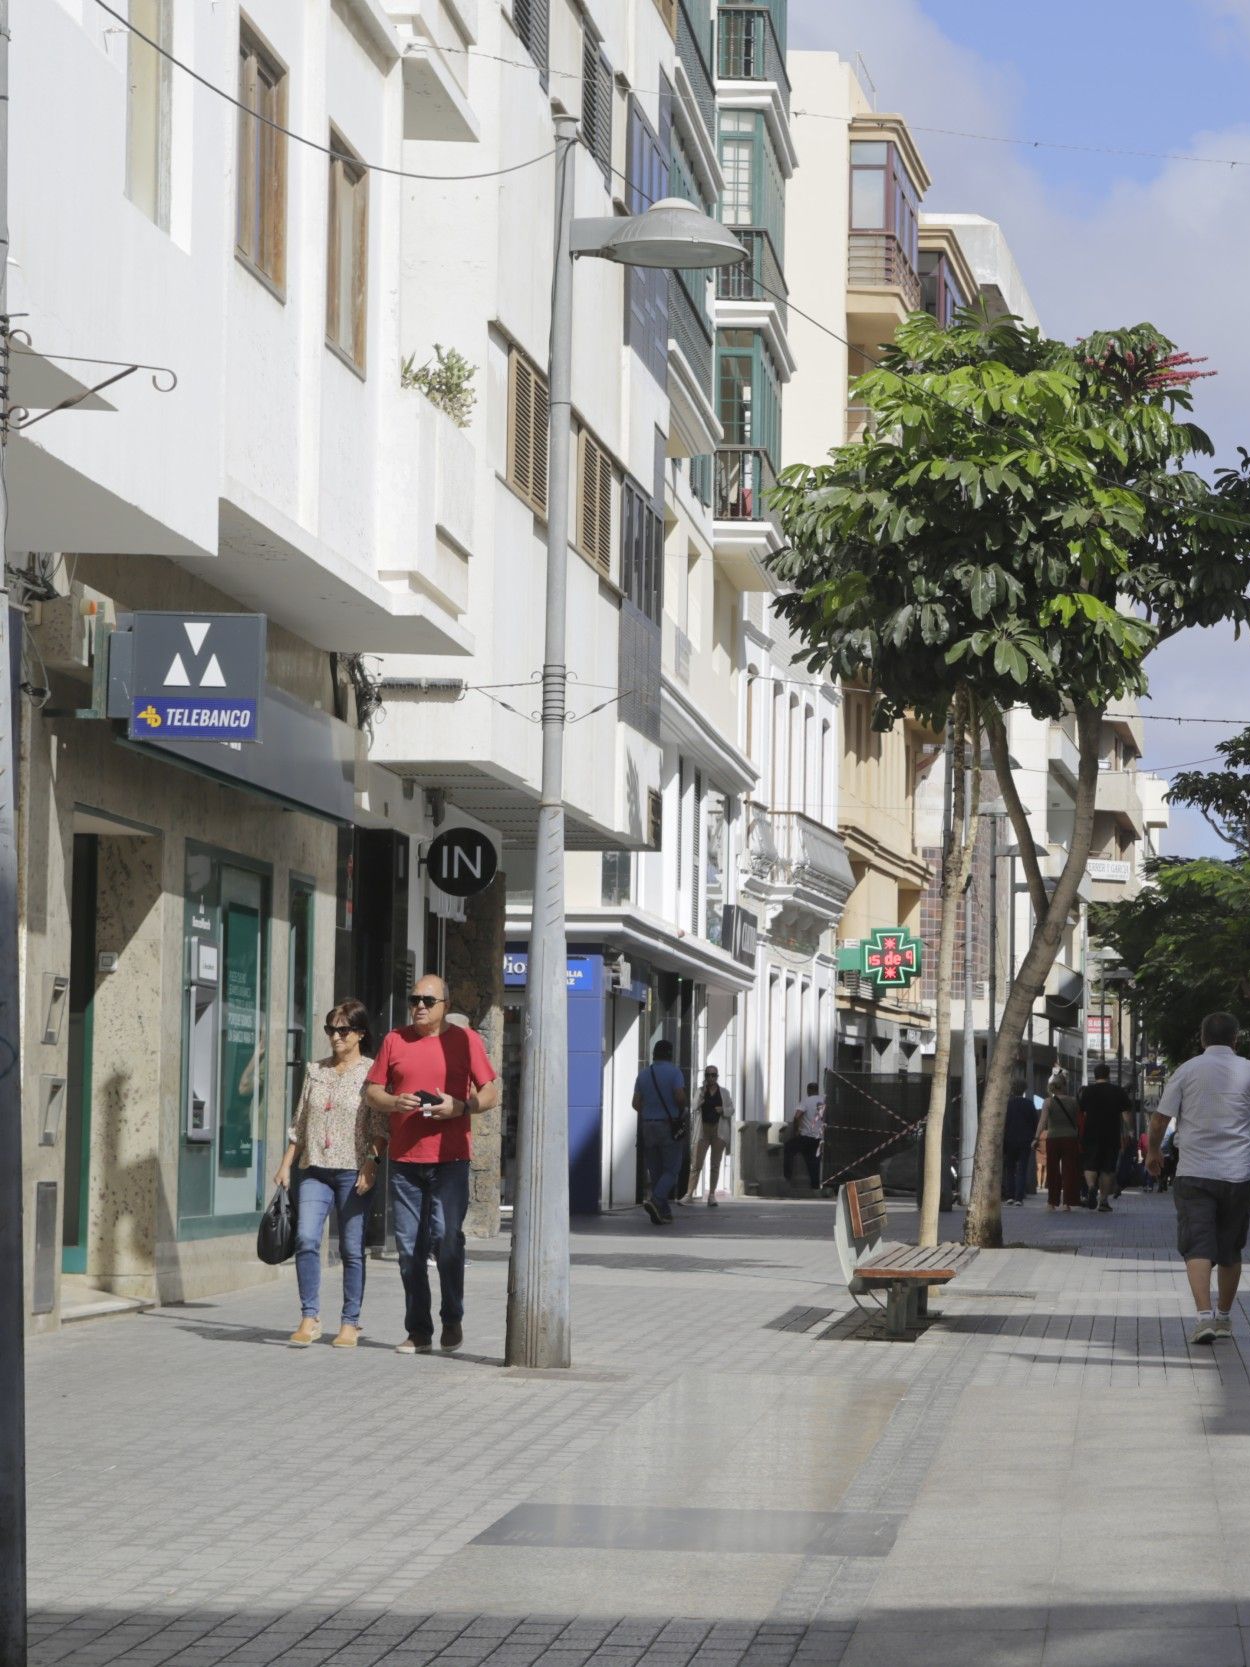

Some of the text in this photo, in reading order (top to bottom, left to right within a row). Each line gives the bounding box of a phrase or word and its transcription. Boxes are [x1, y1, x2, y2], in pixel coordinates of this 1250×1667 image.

[166, 708, 251, 728] TELEBANCO
[442, 845, 482, 879] IN
[884, 951, 902, 966] de
